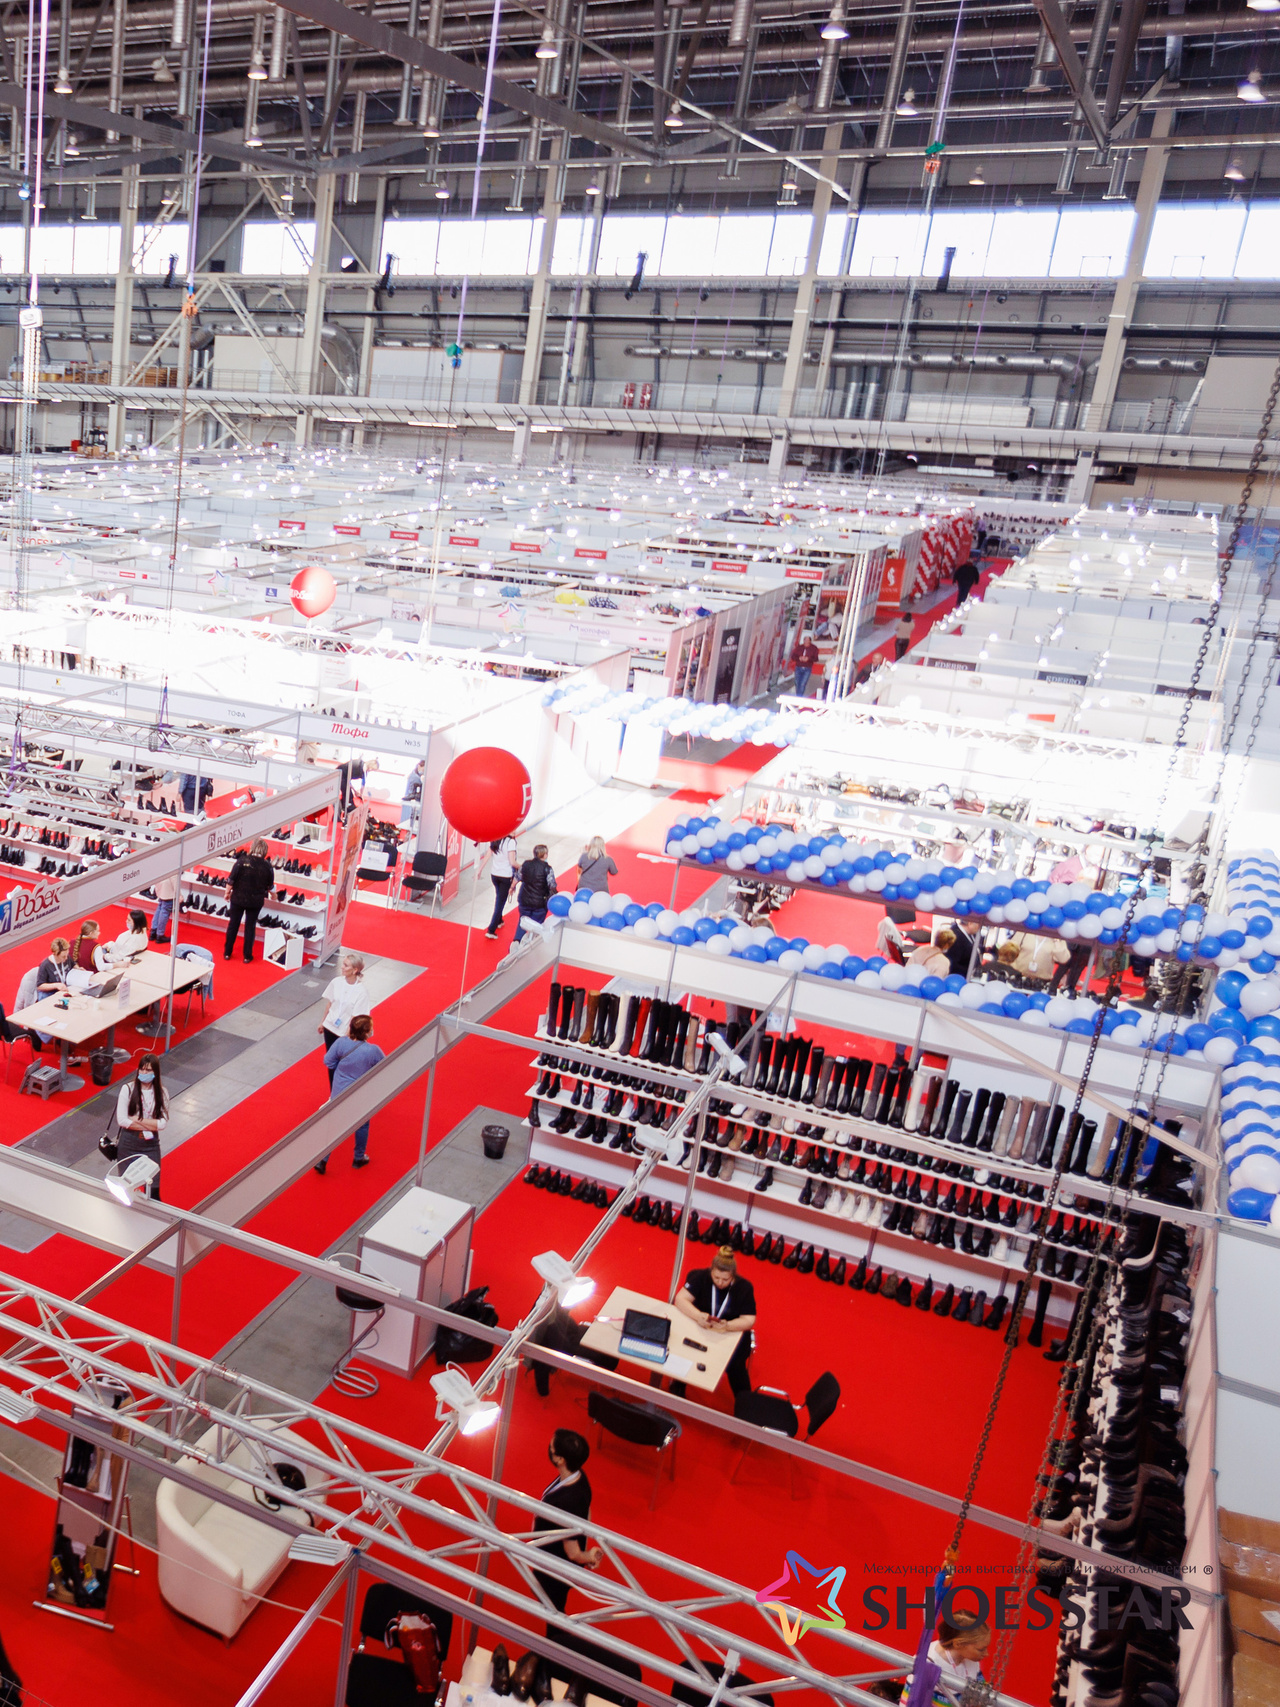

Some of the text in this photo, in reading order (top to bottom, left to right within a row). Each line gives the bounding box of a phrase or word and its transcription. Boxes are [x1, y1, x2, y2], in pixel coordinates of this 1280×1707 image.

[227, 709, 246, 719] ТОФА
[404, 738, 421, 748] №35
[216, 826, 243, 848] BADEN
[122, 868, 141, 882] Baden
[15, 886, 62, 922] Робек
